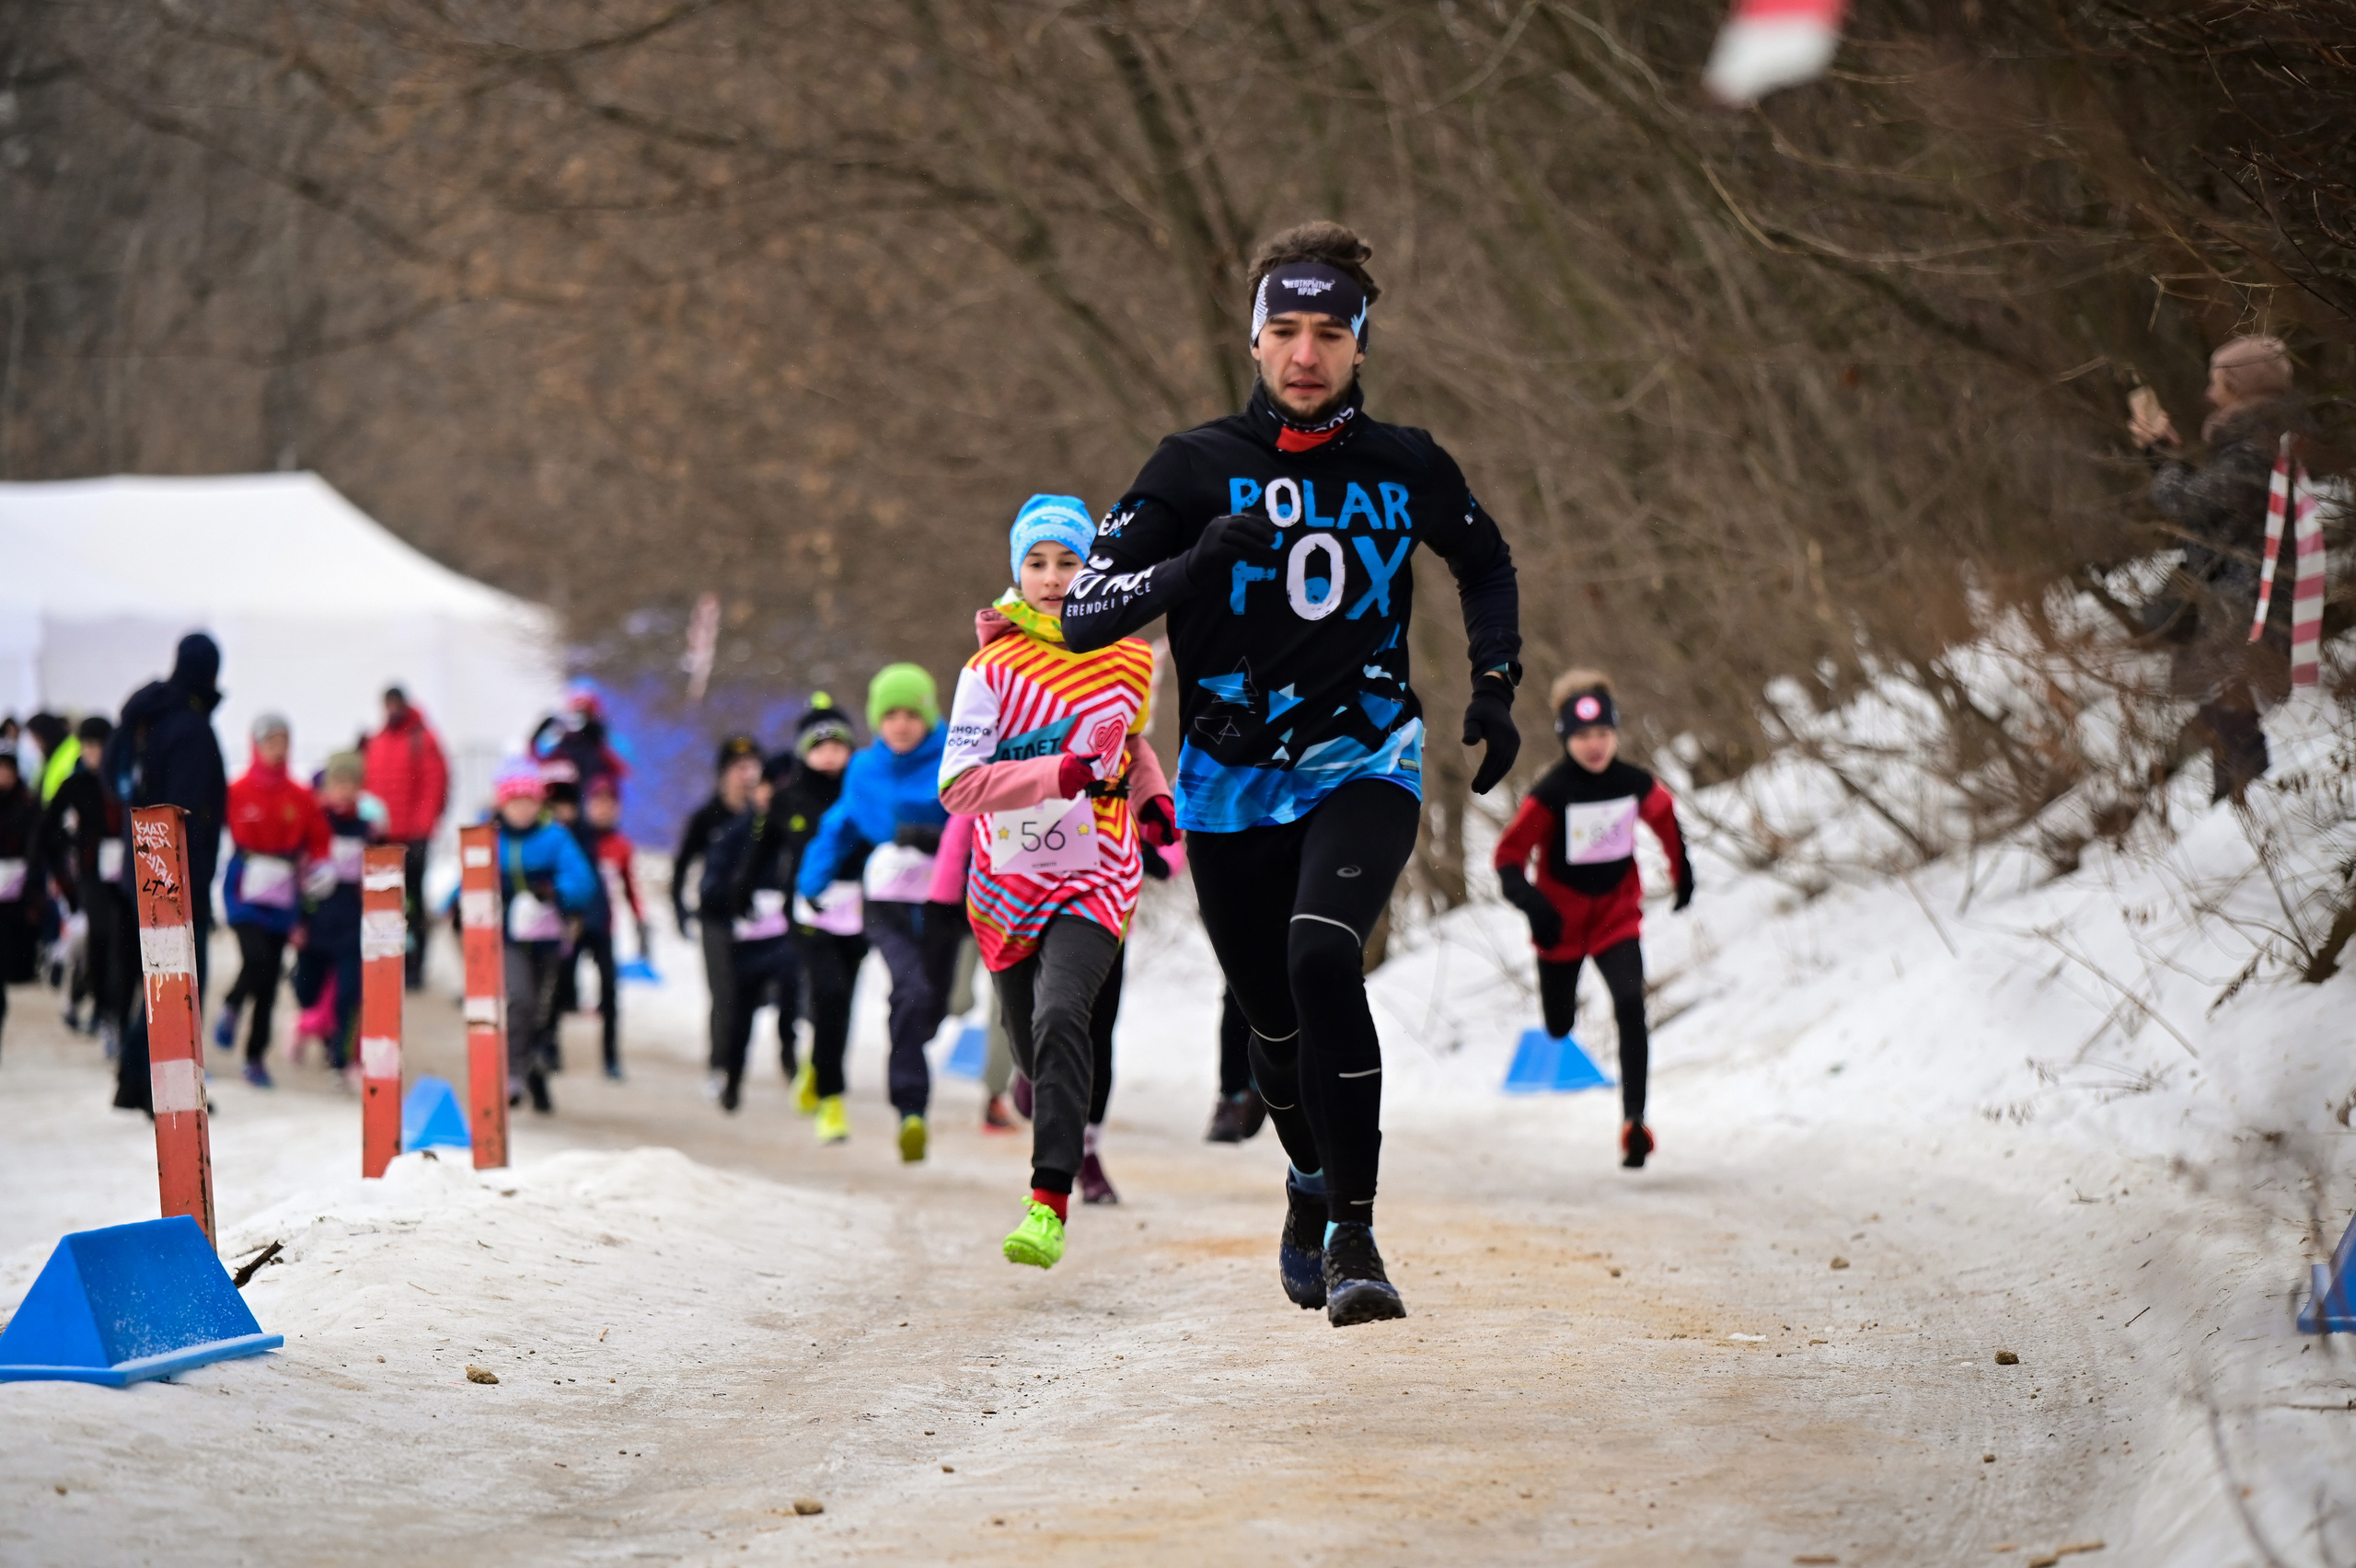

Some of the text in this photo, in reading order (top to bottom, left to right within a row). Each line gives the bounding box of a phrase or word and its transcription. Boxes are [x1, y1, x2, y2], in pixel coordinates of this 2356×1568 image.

[1230, 478, 1413, 530] POLAR
[1230, 532, 1411, 621] FOX
[1022, 819, 1066, 852] 56
